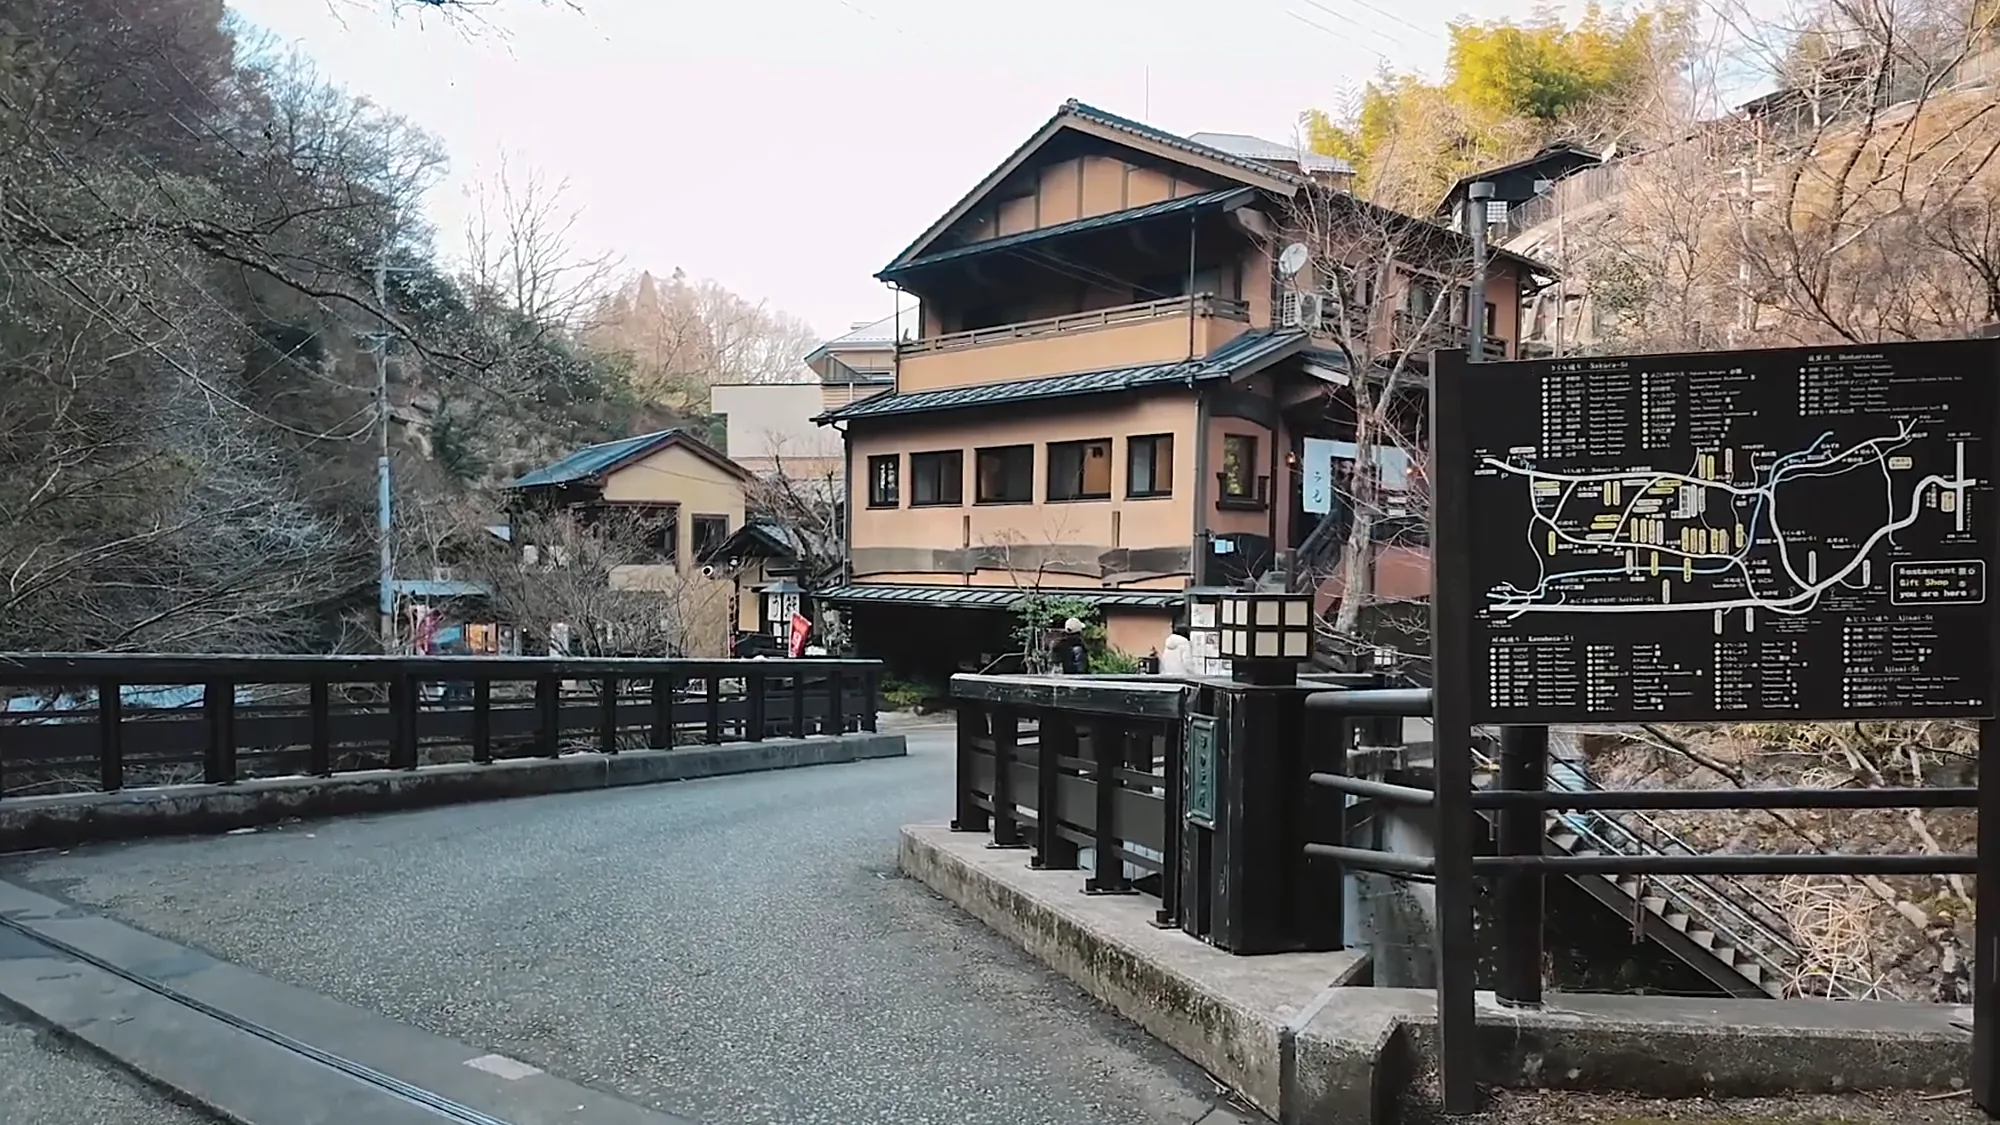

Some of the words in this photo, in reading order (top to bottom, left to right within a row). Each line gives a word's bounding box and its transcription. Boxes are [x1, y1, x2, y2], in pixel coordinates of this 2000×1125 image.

[1899, 567, 1956, 575] Restaurant
[1899, 578, 1919, 587] Gift
[1924, 578, 1949, 587] Shop
[1899, 591, 1917, 599] you
[1943, 589, 1967, 597] here
